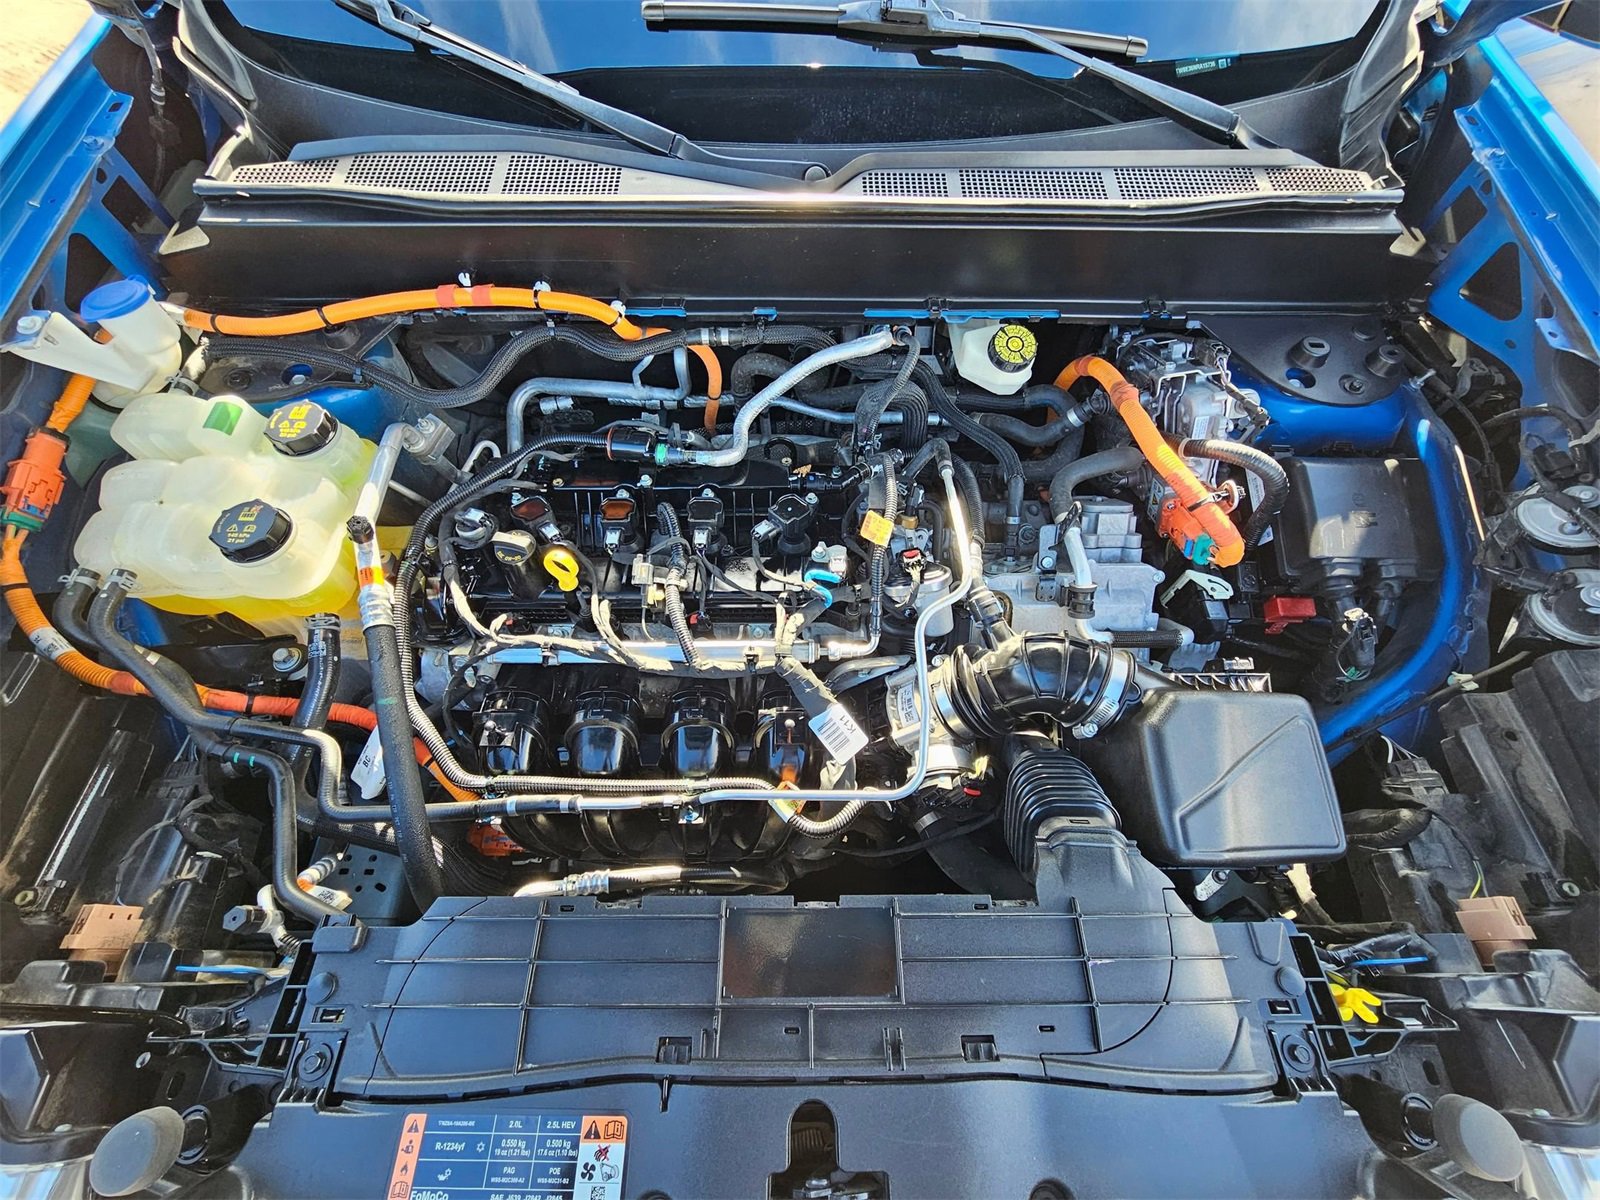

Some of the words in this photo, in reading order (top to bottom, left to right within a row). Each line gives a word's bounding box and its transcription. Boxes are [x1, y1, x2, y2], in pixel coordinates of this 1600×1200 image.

[508, 1120, 523, 1128] 2.0L
[546, 1121, 561, 1129] 2.5L
[561, 1120, 577, 1129] HEV
[435, 1142, 466, 1153] R-1234yf
[501, 1139, 518, 1147] 0.550
[518, 1139, 527, 1149] kg
[546, 1139, 562, 1148] 0.500
[562, 1139, 571, 1150] kg
[520, 1149, 531, 1157] lbs)
[567, 1149, 578, 1158] lbs)
[503, 1166, 516, 1175] PAG
[549, 1167, 561, 1175] POE
[410, 1191, 449, 1200] FoMoCo
